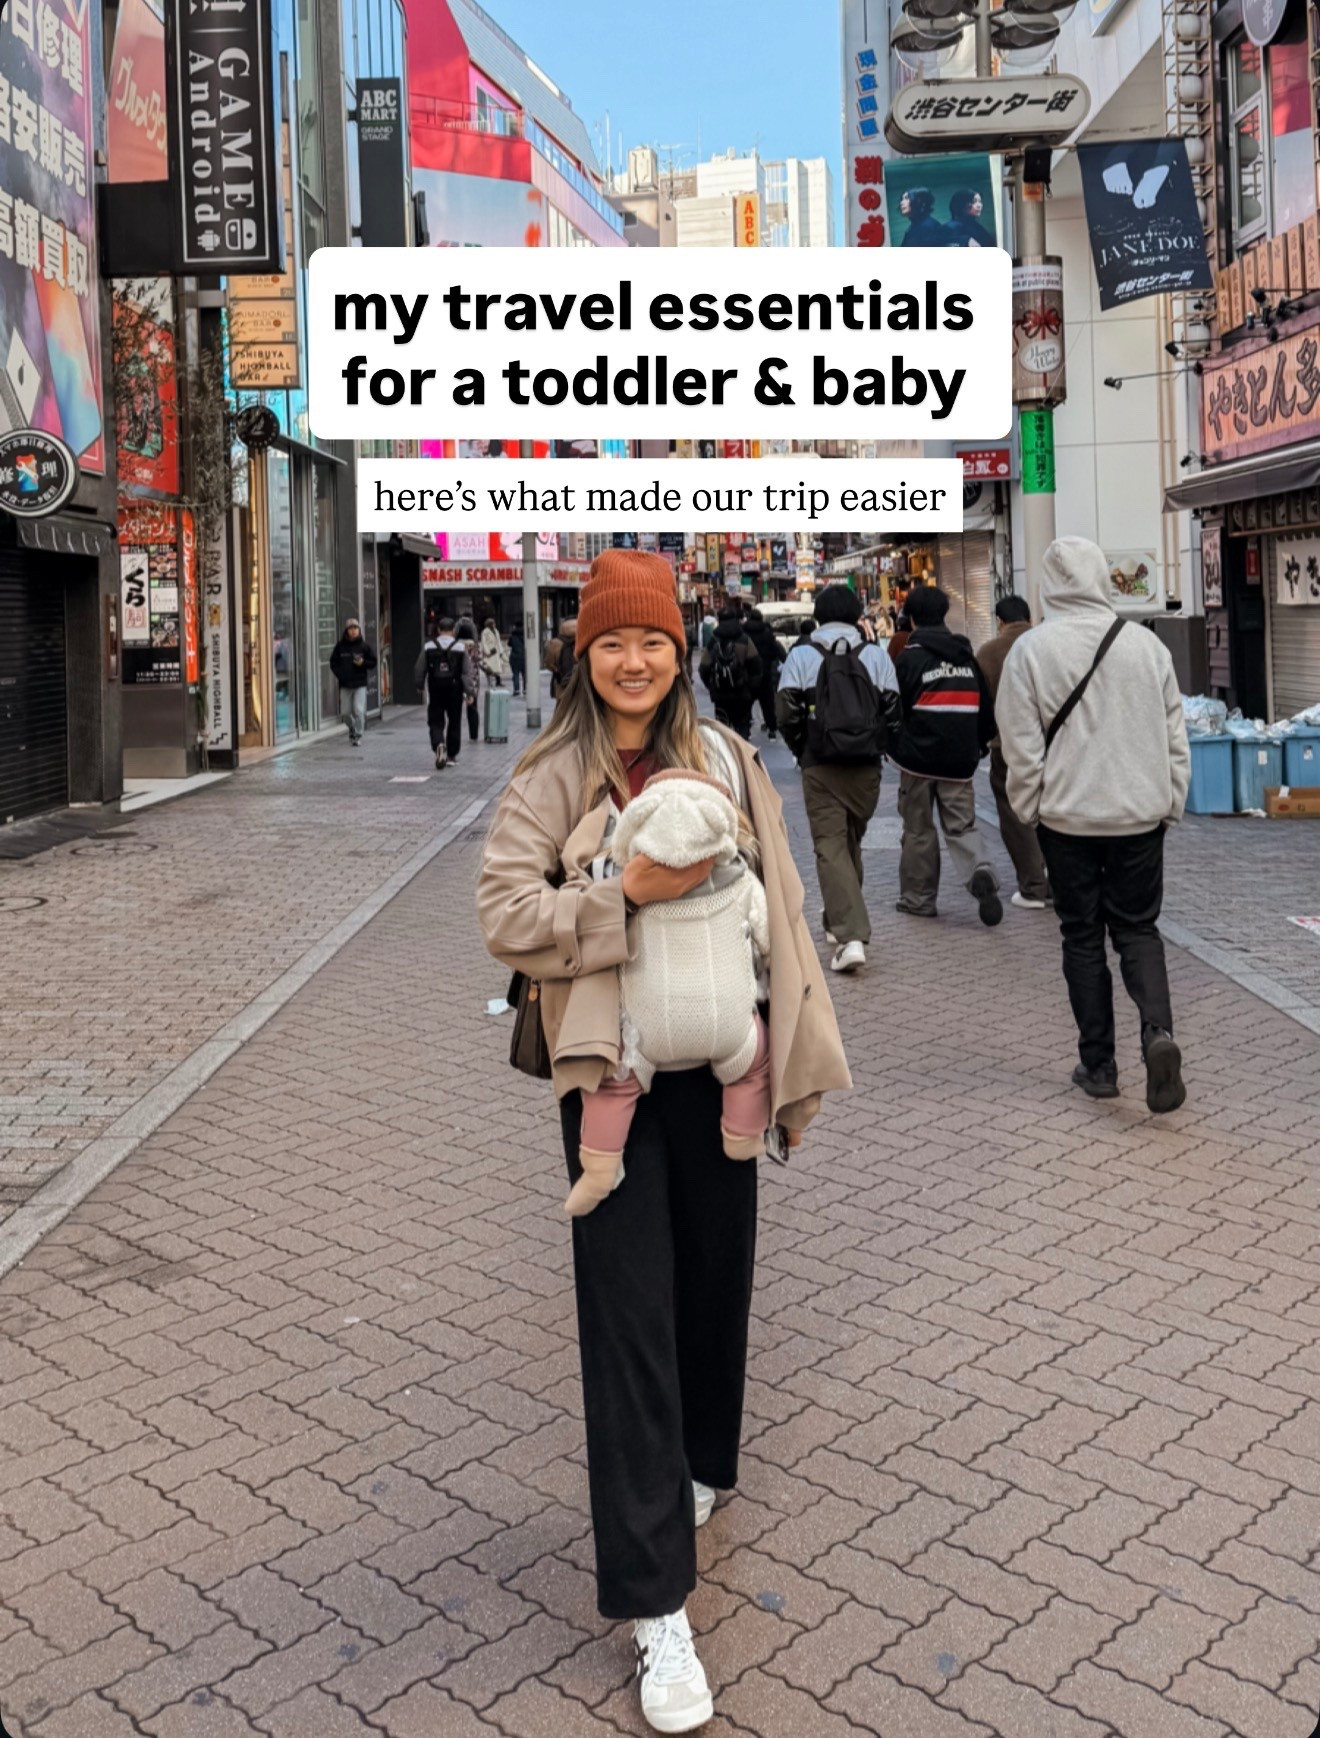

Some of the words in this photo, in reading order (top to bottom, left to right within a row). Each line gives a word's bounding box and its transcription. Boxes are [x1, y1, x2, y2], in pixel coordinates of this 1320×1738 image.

[2, 0, 84, 97] 日修理
[360, 89, 397, 107] ABC
[360, 108, 398, 121] MART
[905, 89, 1078, 120] 渋谷センター街
[188, 50, 221, 224] Android
[218, 47, 255, 210] GAME
[744, 200, 756, 246] ABC
[1100, 238, 1154, 268] JANE
[1158, 235, 1201, 251] DOE
[125, 568, 146, 607] くら
[422, 568, 462, 583] SMASH
[212, 634, 221, 676] SHIBUYA
[213, 680, 222, 729] HIGHBALL
